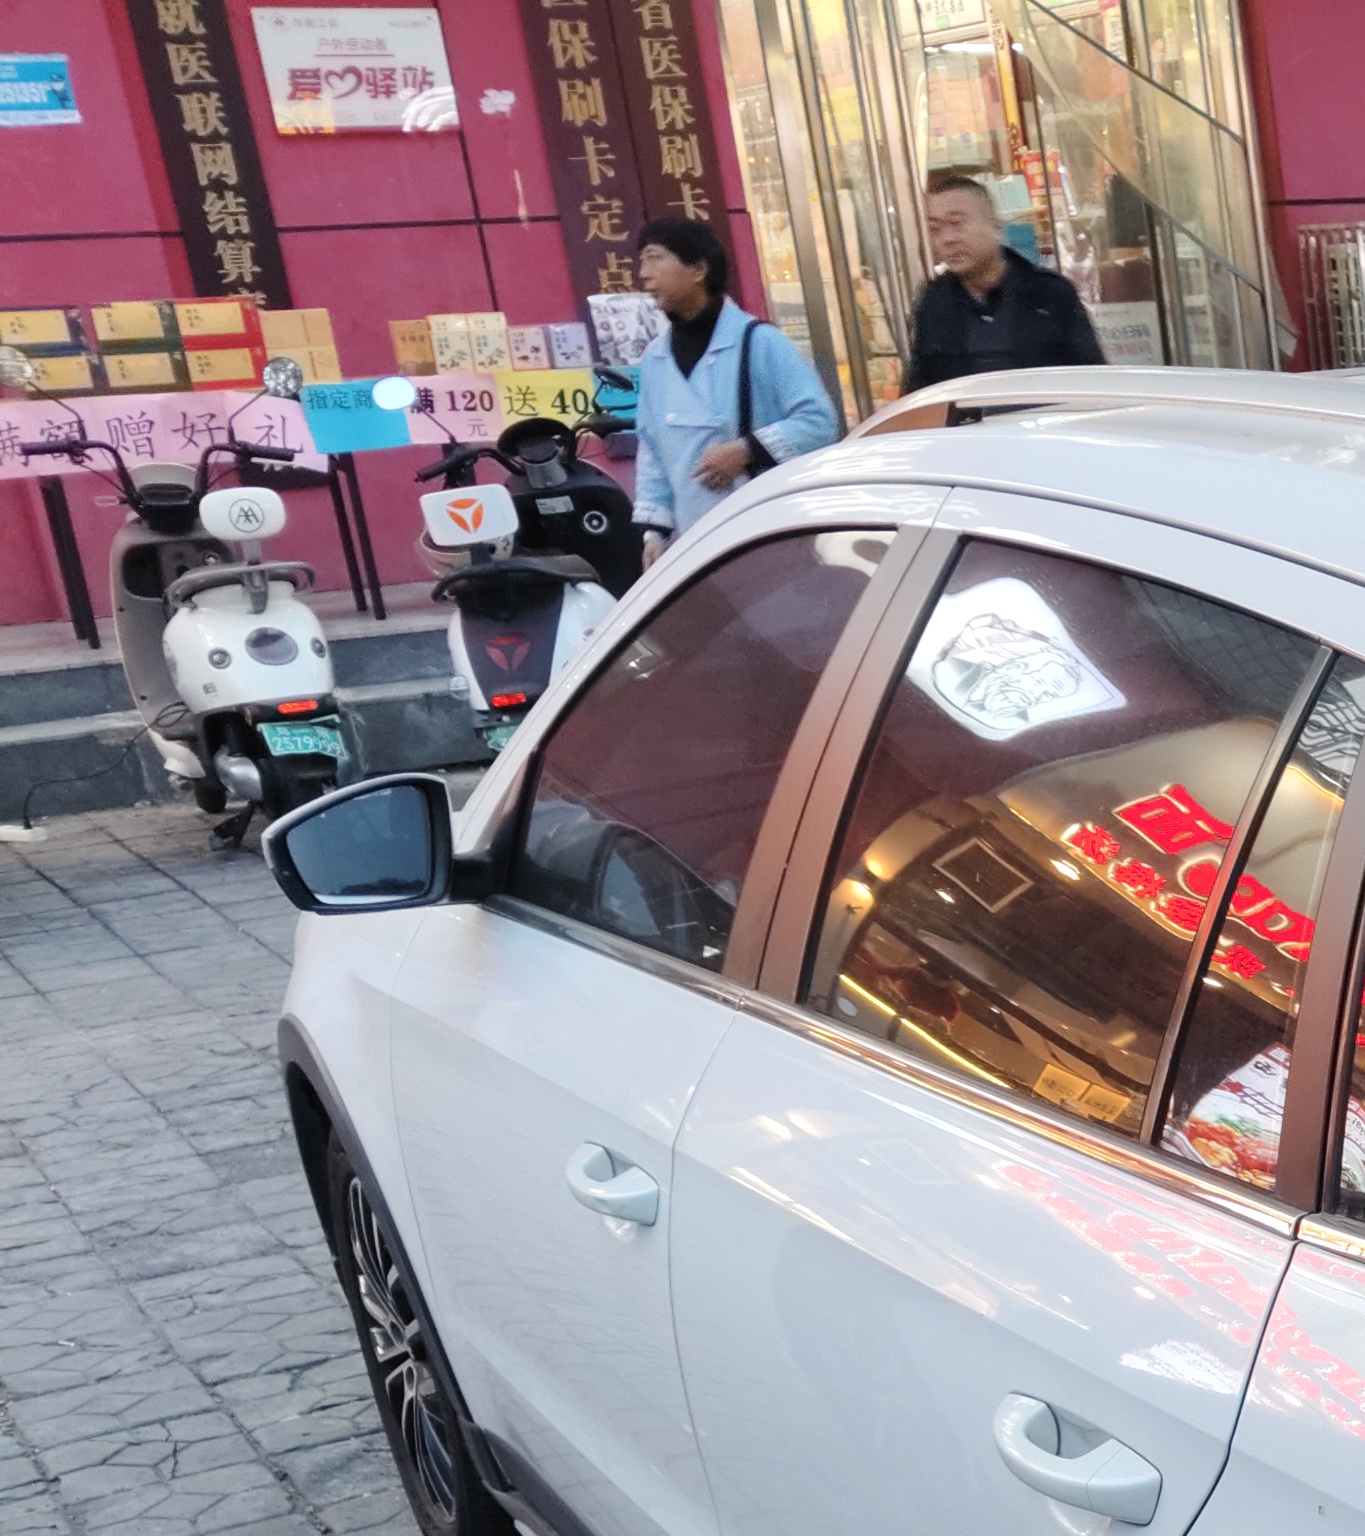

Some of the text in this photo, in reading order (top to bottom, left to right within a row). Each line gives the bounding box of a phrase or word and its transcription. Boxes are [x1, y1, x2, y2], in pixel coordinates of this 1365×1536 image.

[541, 0, 633, 293] 保刷卡定点
[446, 390, 494, 412] 120
[506, 387, 540, 417] 送
[467, 418, 489, 438] 元
